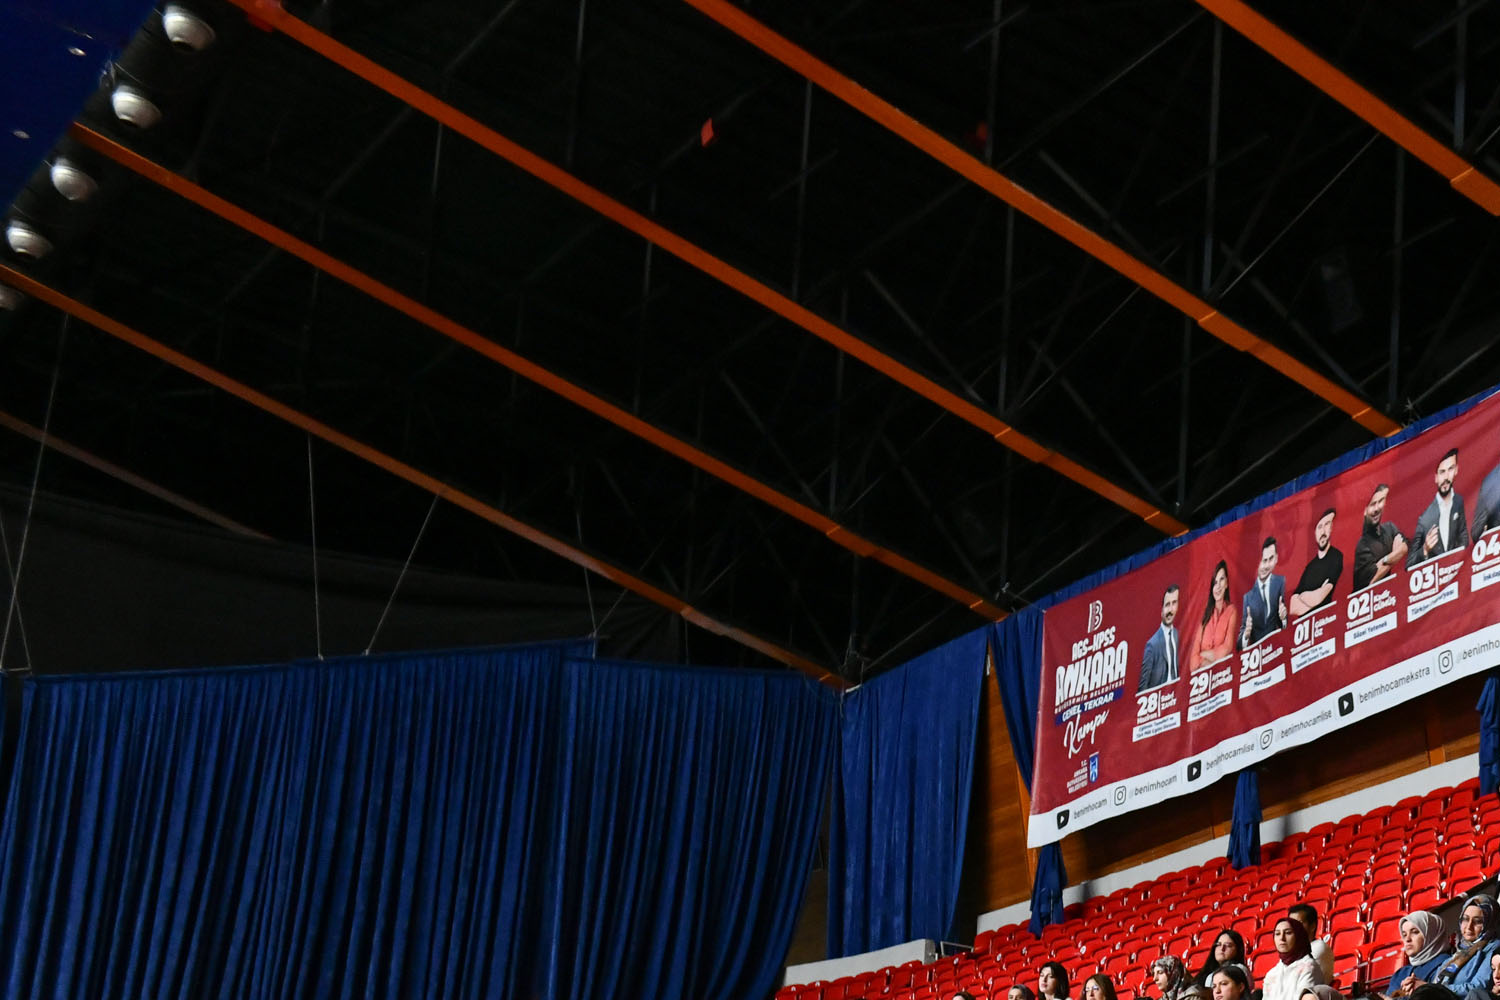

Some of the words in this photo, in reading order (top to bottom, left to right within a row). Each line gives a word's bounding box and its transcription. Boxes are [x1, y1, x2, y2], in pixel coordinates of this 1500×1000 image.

[1409, 564, 1435, 593] 03
[1347, 592, 1370, 620] 02
[1293, 619, 1310, 646] 01
[1055, 640, 1128, 706] ANKARA
[1240, 648, 1260, 674] 30
[1189, 672, 1209, 697] 29
[1359, 665, 1431, 704] benimhocamekstra
[1084, 692, 1115, 712] TEKRAR
[1136, 692, 1158, 717] 28
